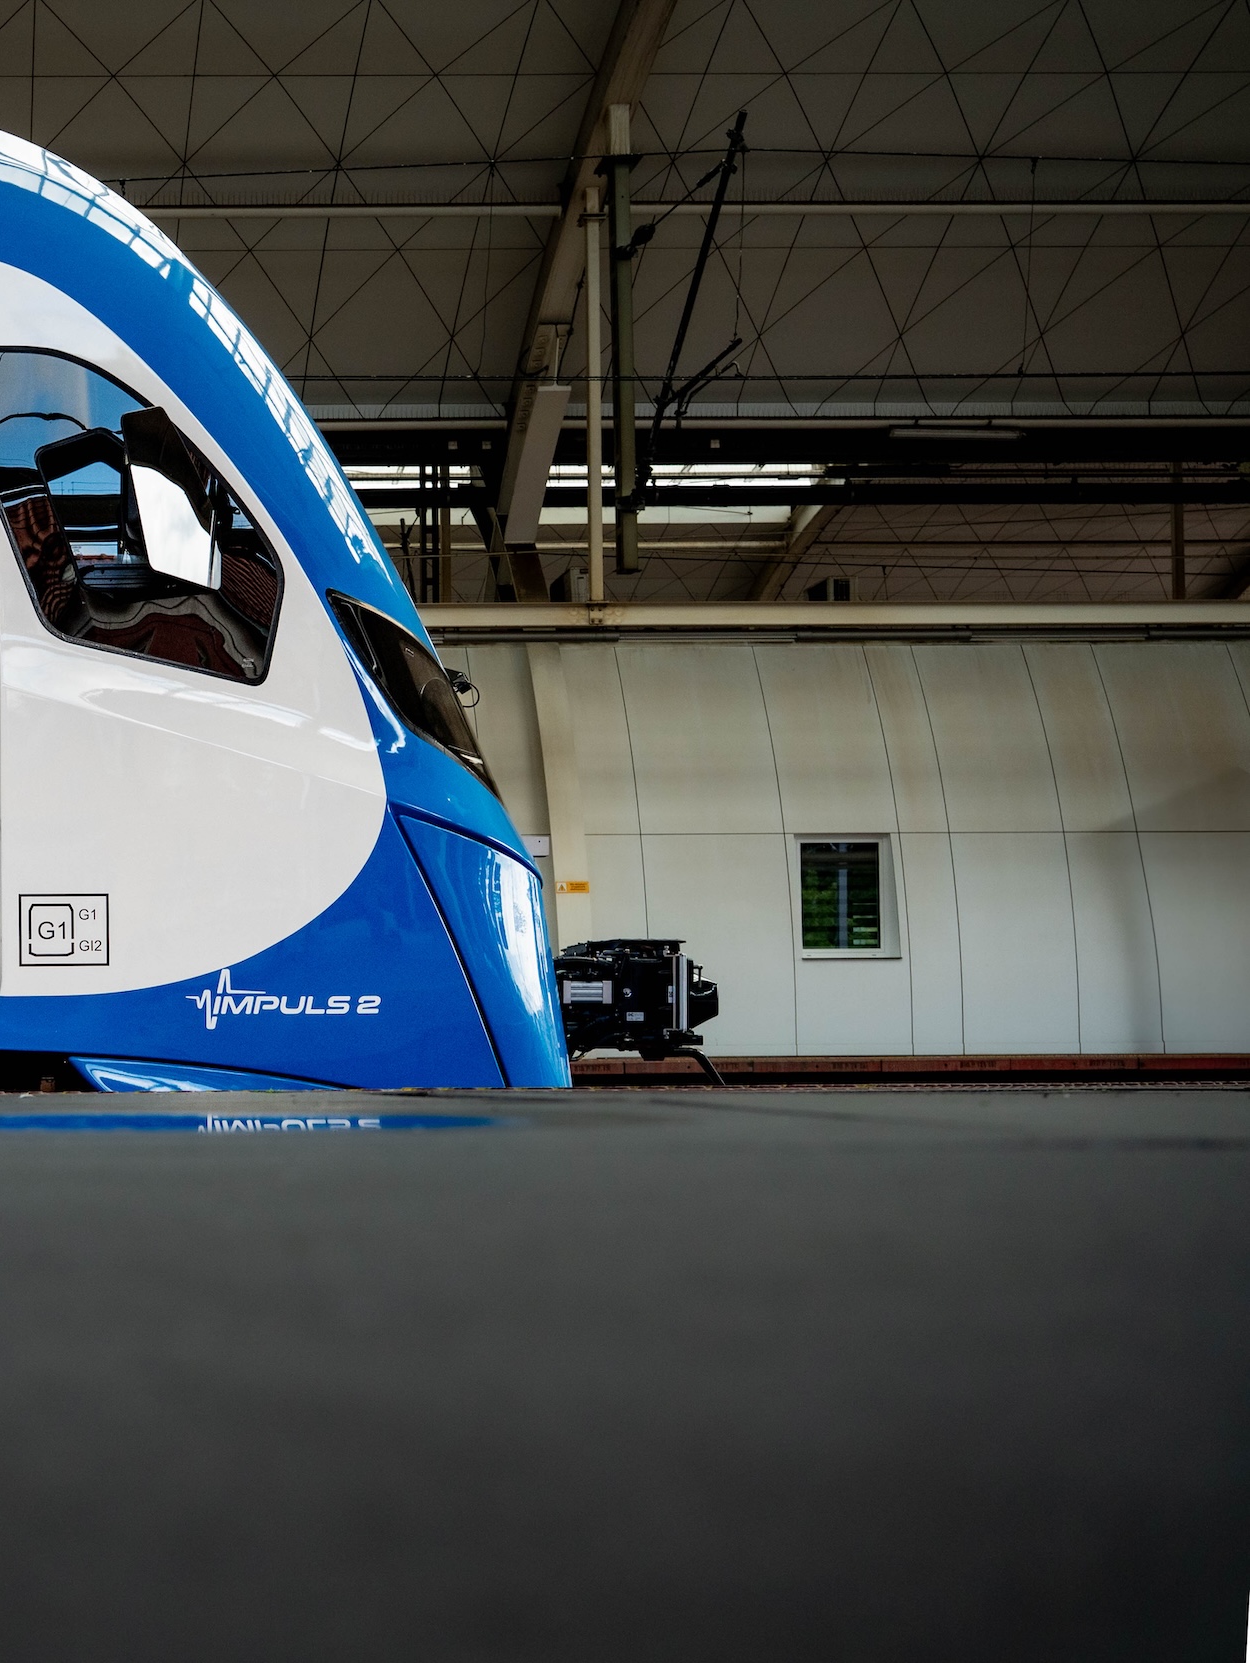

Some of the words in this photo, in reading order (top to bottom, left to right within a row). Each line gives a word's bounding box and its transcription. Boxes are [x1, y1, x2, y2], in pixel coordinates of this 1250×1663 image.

[78, 908, 96, 921] G1
[38, 921, 66, 940] G1
[356, 995, 382, 1015] 2
